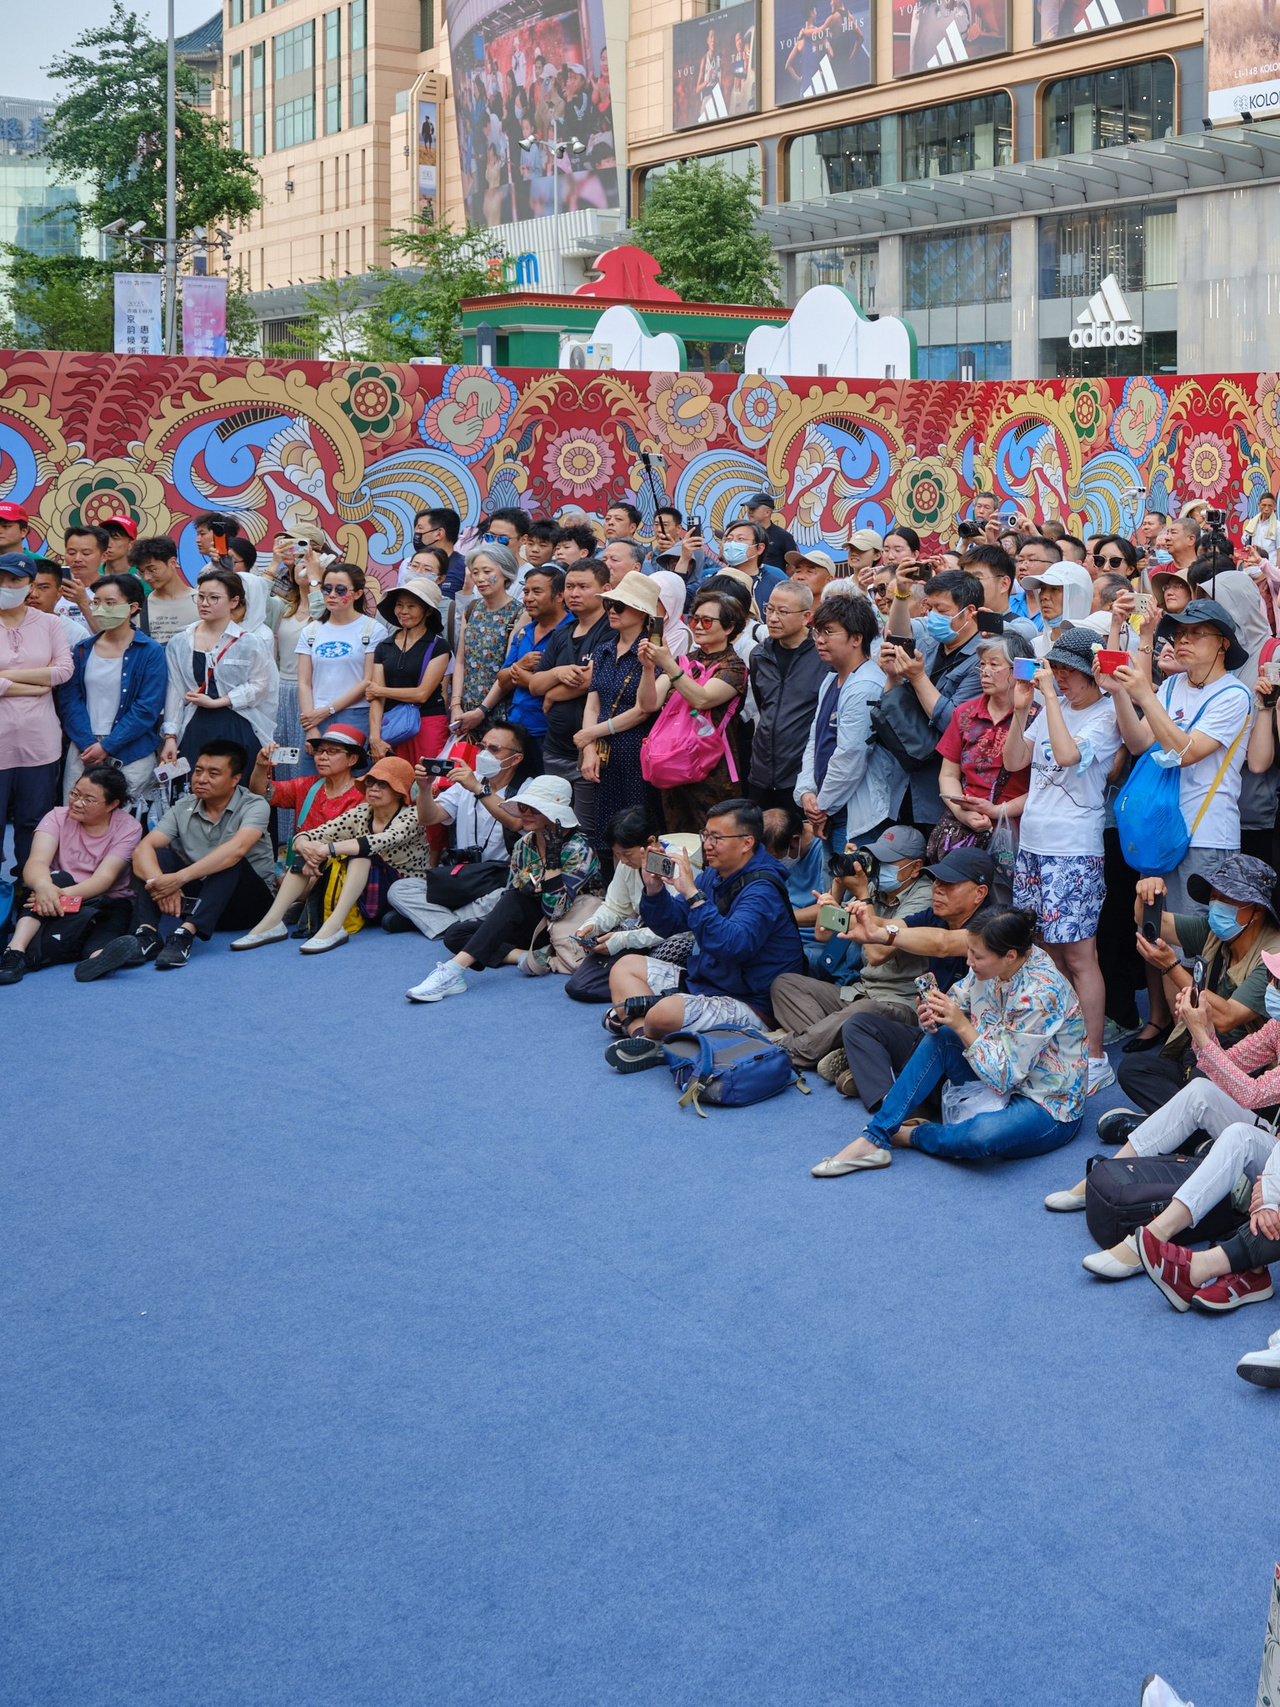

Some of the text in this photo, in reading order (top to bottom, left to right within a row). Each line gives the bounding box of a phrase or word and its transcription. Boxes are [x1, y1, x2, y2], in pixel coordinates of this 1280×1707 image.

[780, 17, 875, 50] YOU GOT THIS
[677, 65, 695, 78] YOU
[1234, 68, 1258, 79] L1-148
[1068, 320, 1143, 349] adidas
